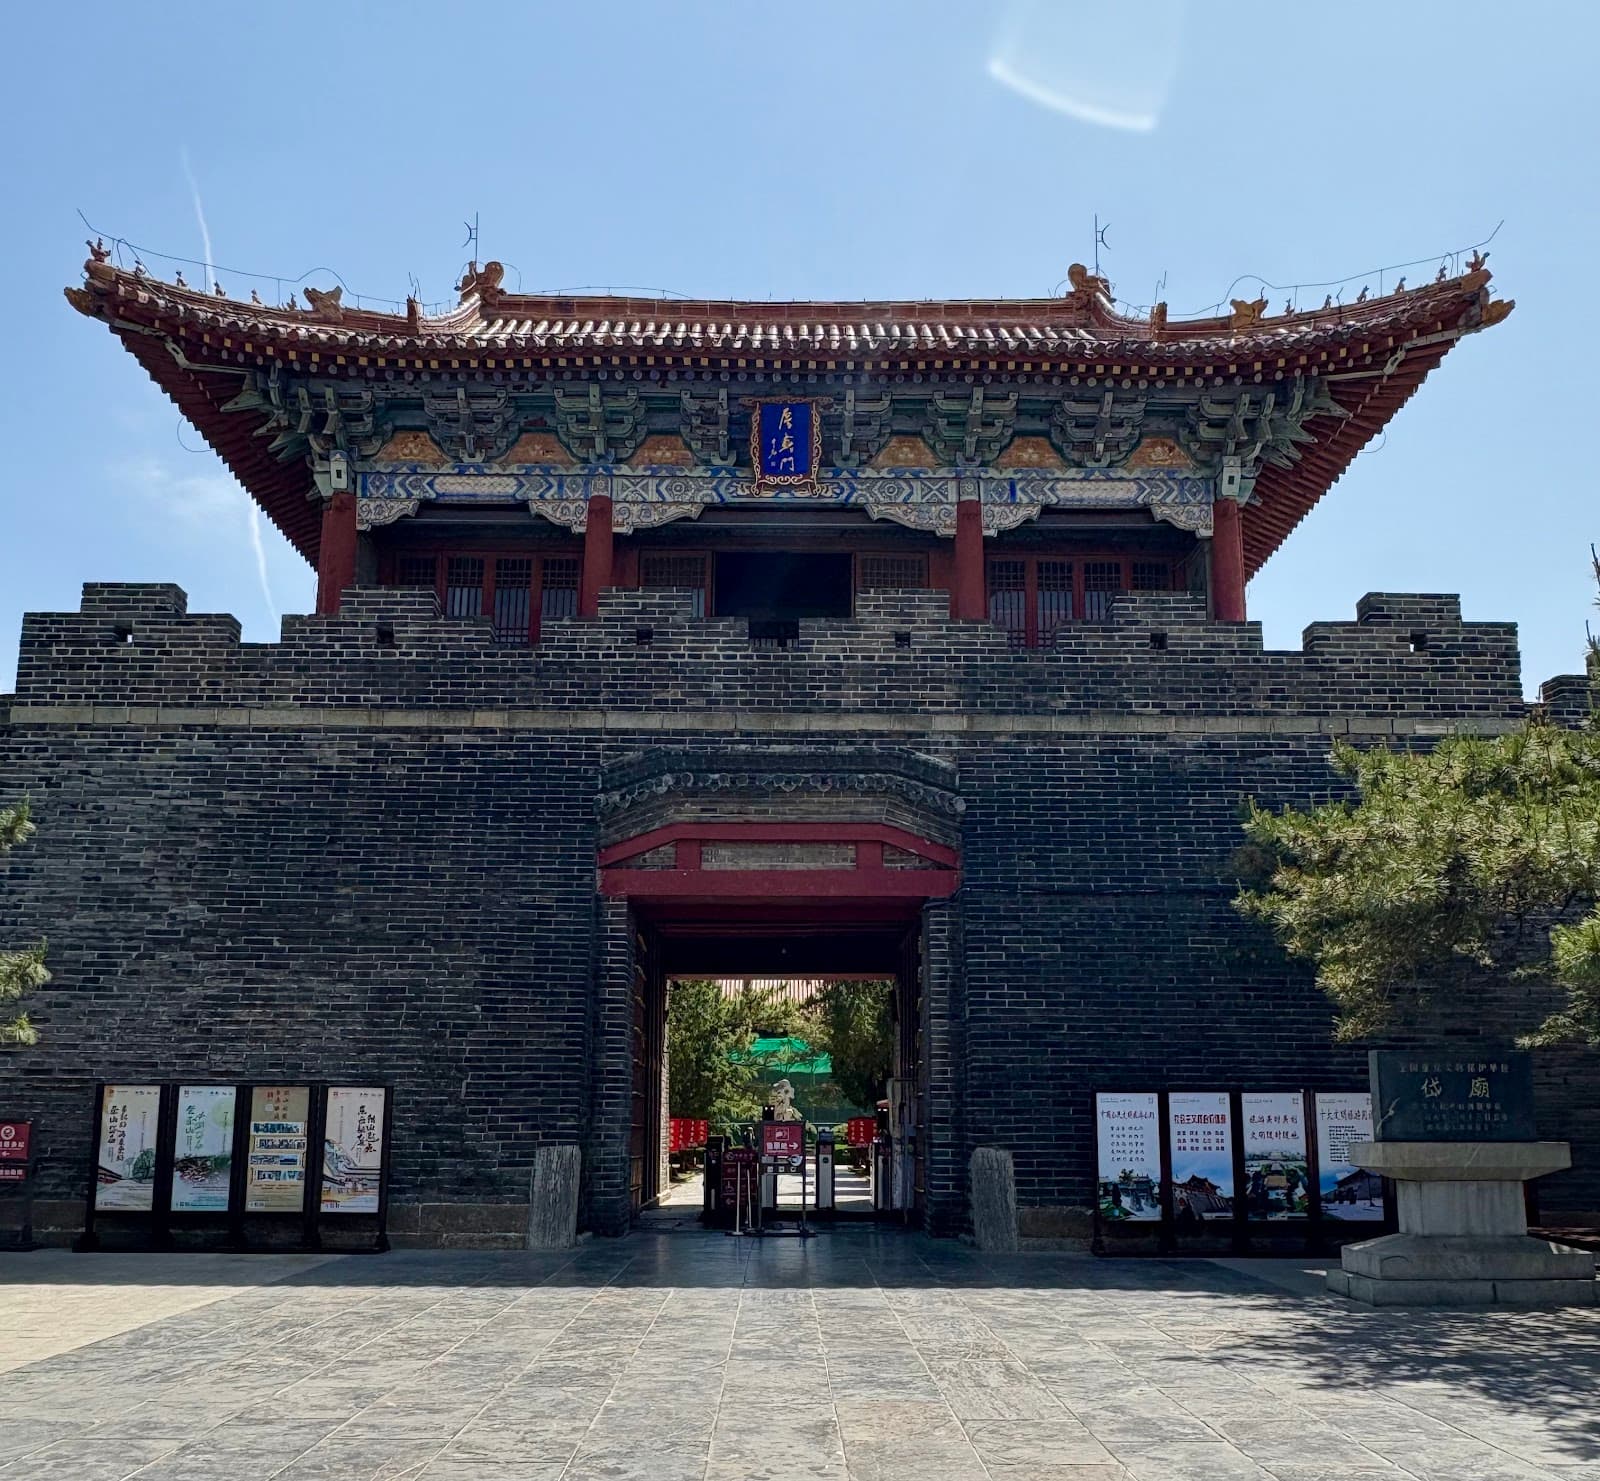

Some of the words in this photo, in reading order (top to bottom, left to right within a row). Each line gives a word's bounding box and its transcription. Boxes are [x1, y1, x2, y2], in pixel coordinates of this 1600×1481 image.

[1174, 1114, 1226, 1124] 社会主义核心价值观
